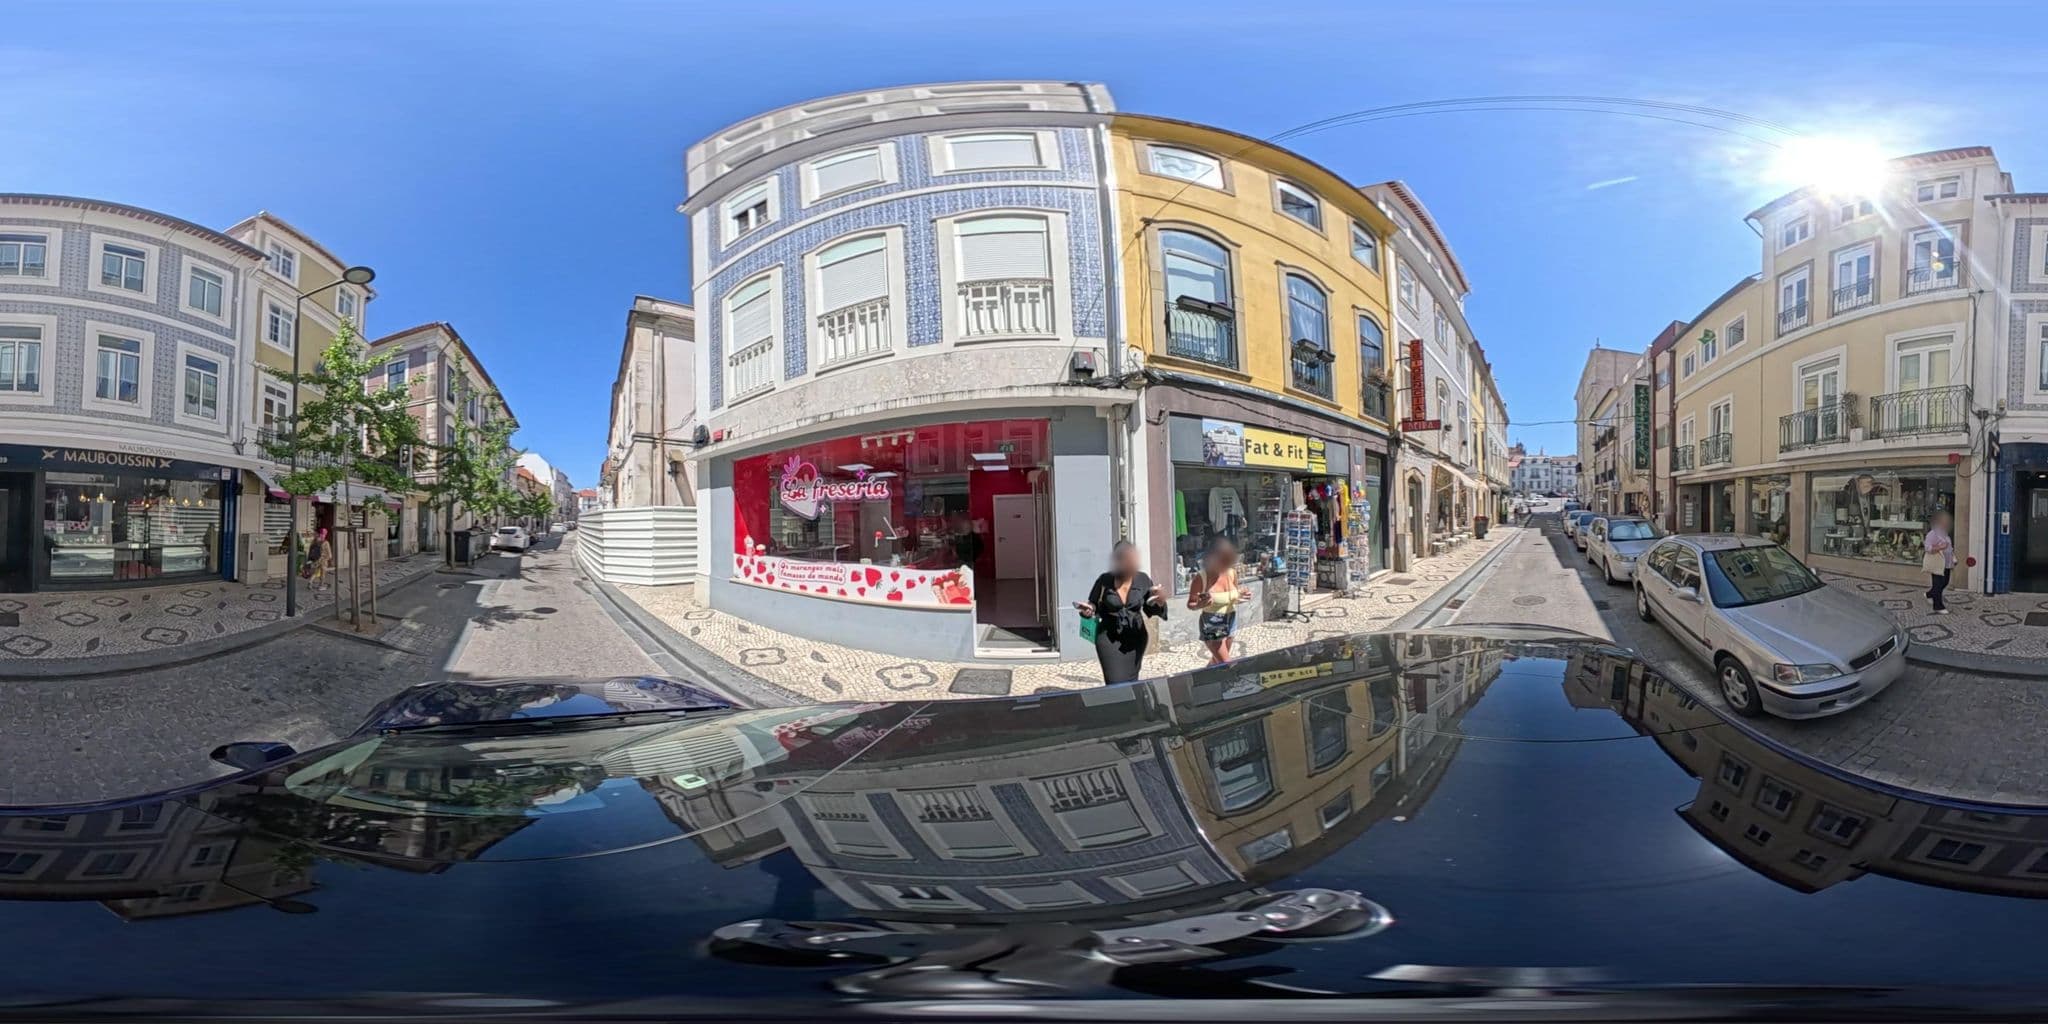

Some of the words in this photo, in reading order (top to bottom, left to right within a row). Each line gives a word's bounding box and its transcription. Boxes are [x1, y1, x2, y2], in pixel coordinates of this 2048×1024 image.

[1245, 438, 1269, 455] Fat
[1273, 443, 1283, 457] &
[1288, 445, 1303, 460] Fit
[63, 450, 157, 468] MAUBOUSSIN
[781, 478, 807, 501] La
[812, 476, 890, 502] fresería
[818, 573, 843, 582] mundo
[825, 565, 843, 574] mais
